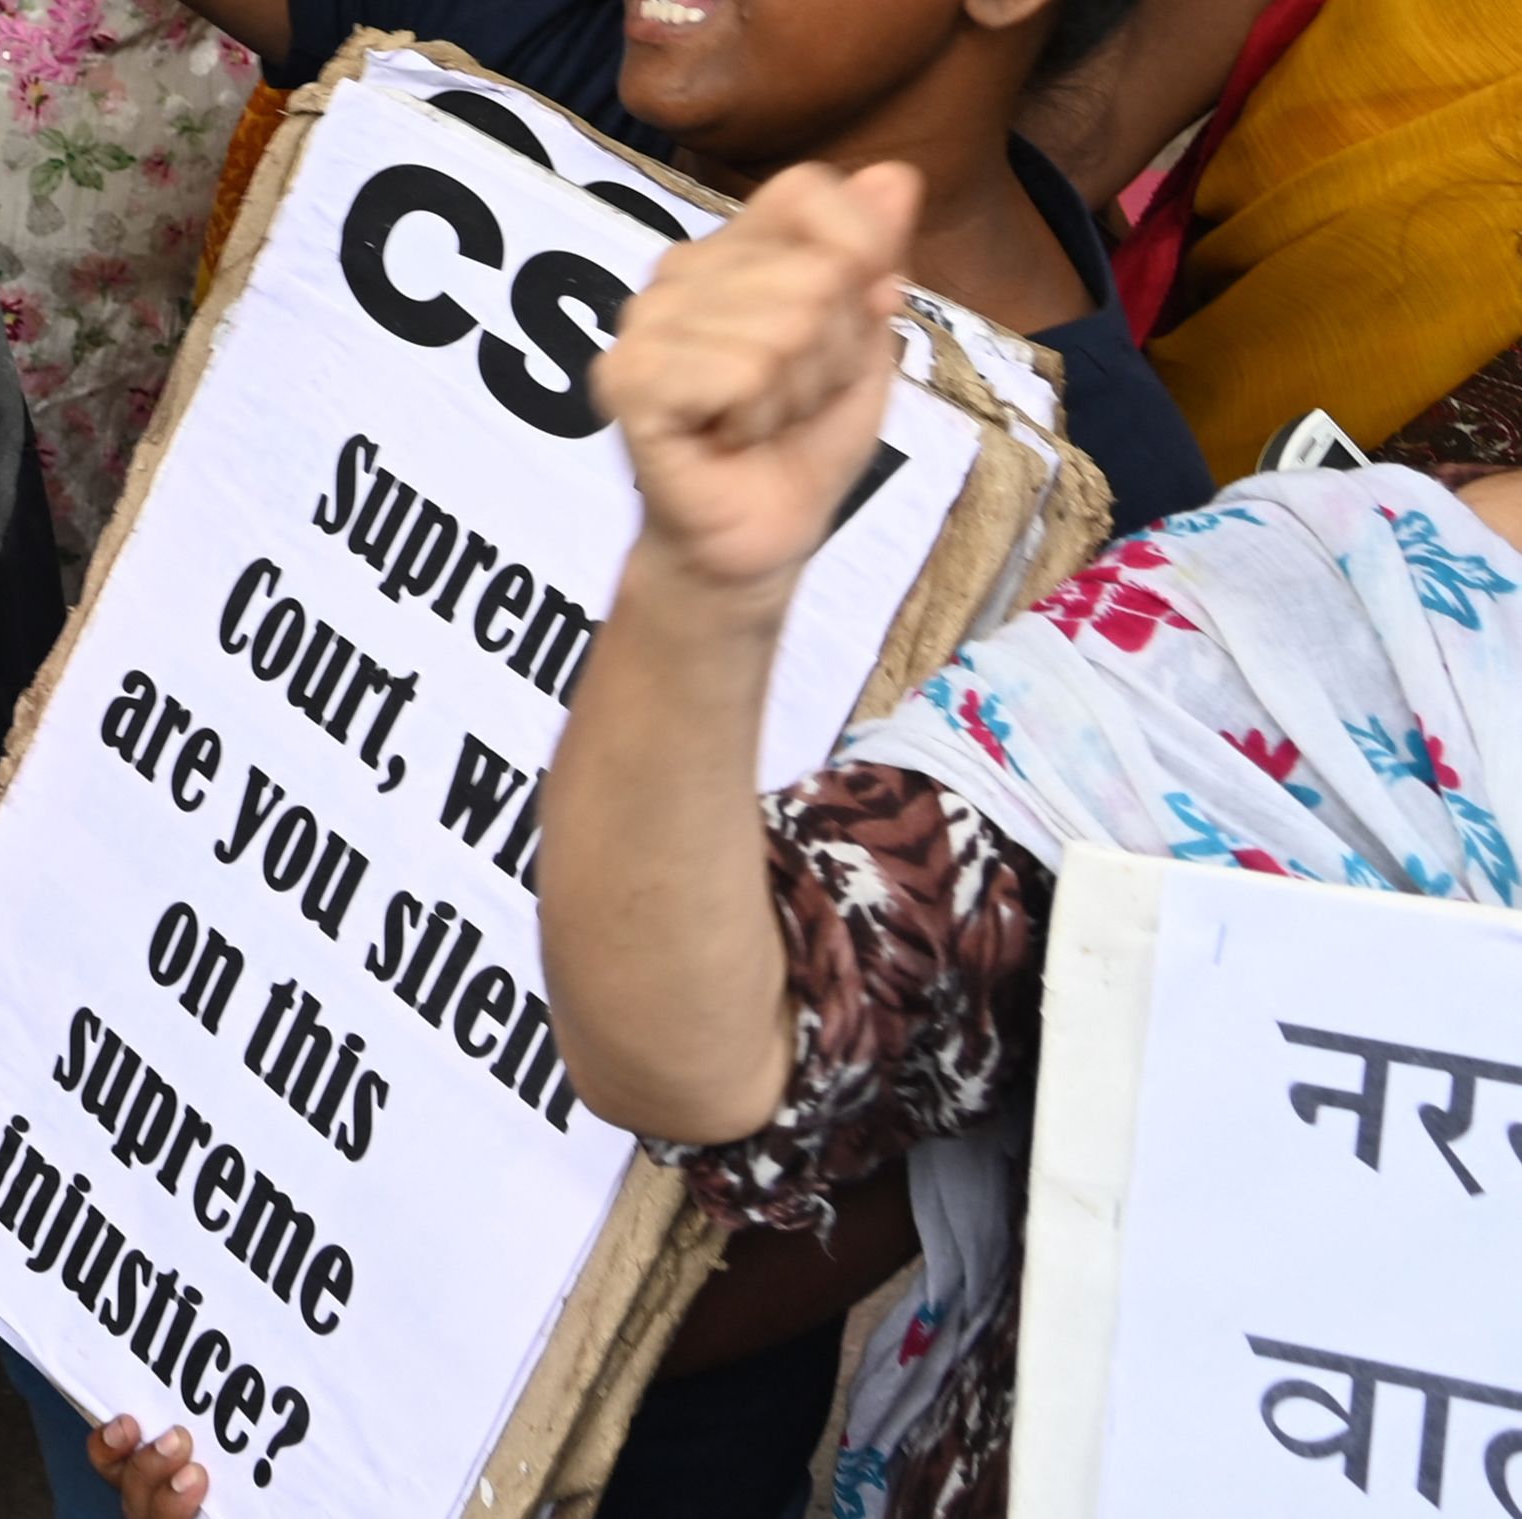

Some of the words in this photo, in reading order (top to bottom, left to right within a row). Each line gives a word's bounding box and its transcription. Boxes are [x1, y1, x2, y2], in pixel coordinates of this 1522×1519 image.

[101, 671, 221, 812] are
[215, 766, 368, 940] you
[220, 558, 418, 793] Court,
[149, 902, 243, 1035] on
[245, 979, 388, 1161] this
[54, 1007, 354, 1336] supreme
